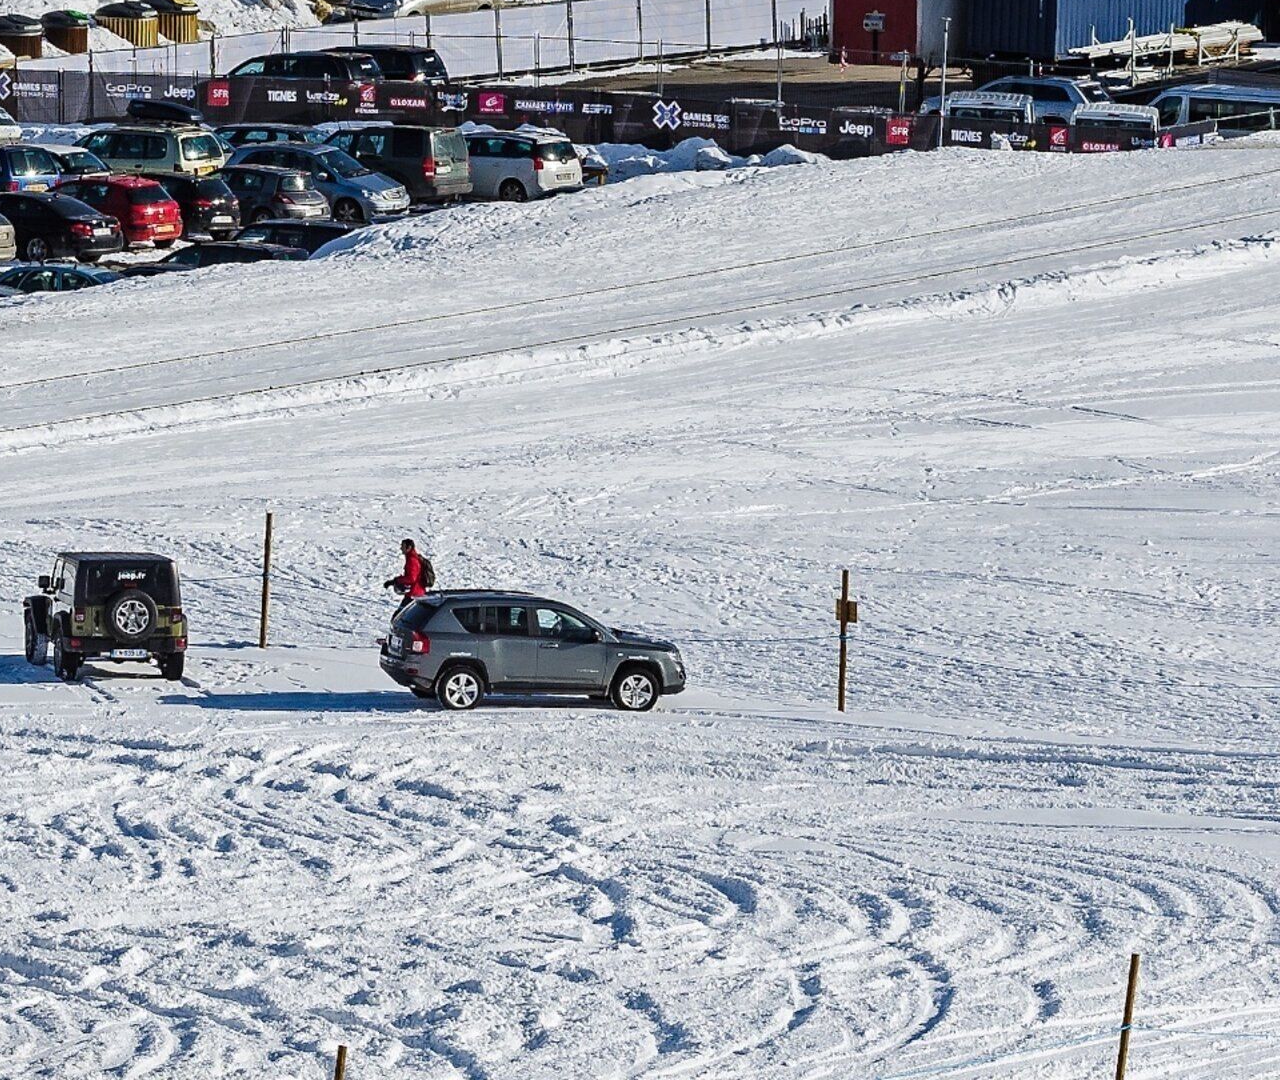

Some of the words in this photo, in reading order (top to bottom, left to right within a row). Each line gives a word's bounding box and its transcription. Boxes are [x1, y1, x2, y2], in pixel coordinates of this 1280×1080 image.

[105, 82, 152, 93] GoPro
[163, 84, 196, 101] Jeep
[213, 88, 230, 99] SFR
[267, 90, 297, 102] TIGNES
[682, 112, 712, 122] GAMES
[779, 116, 827, 127] GoPro
[839, 120, 873, 138] Jeep
[891, 126, 909, 137] SFR
[951, 129, 982, 143] TIGNES
[117, 571, 146, 581] jeep.fr
